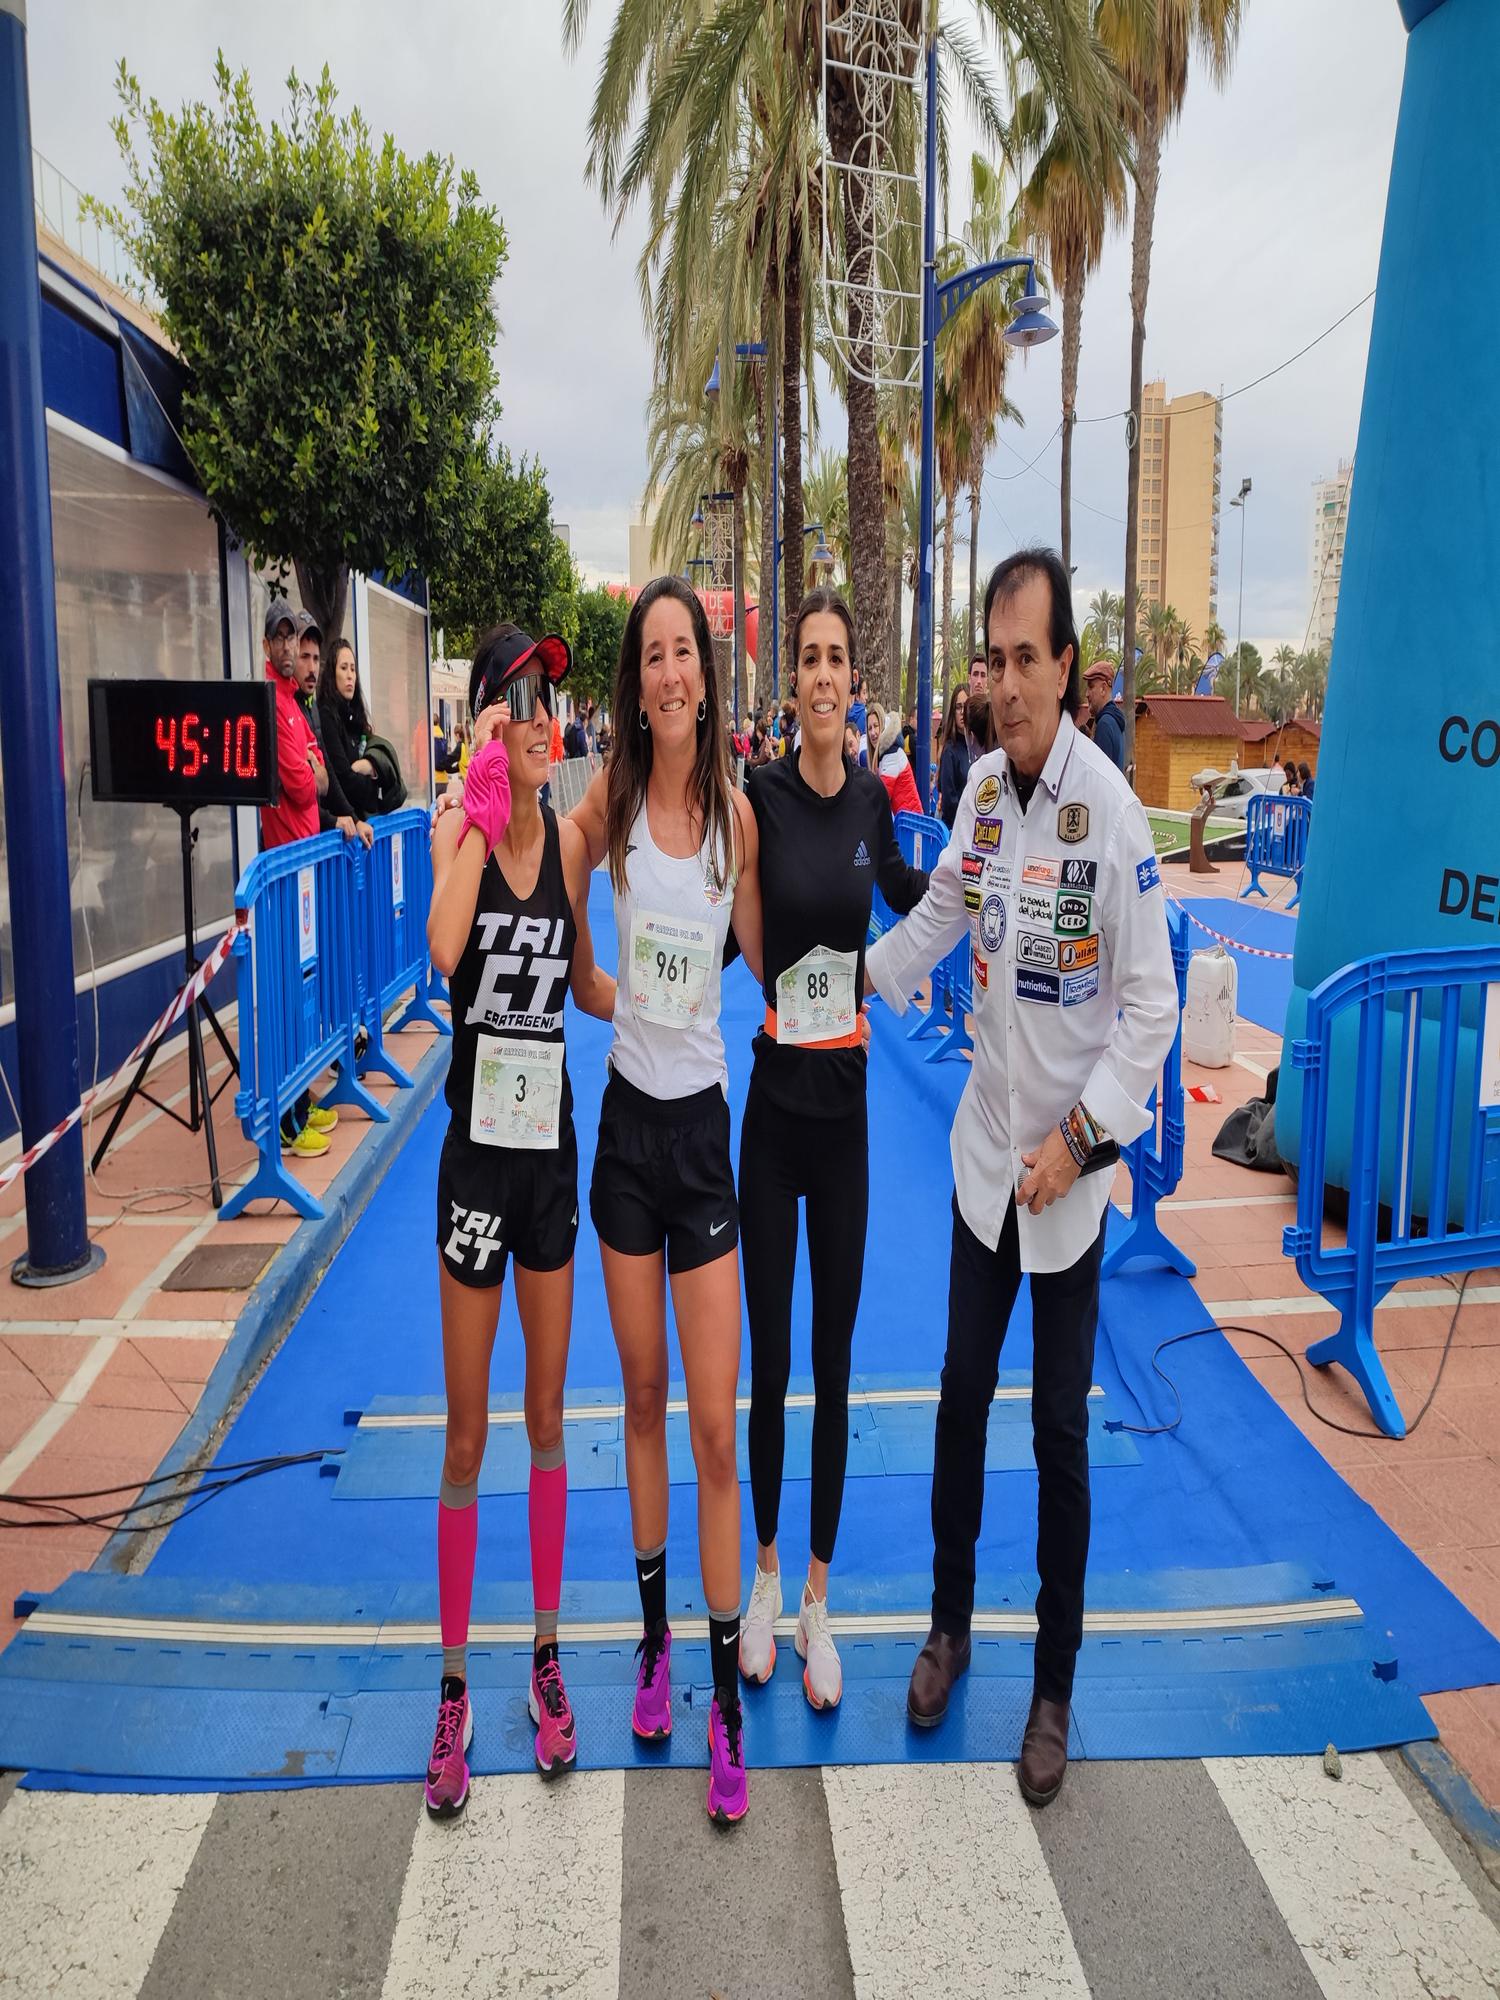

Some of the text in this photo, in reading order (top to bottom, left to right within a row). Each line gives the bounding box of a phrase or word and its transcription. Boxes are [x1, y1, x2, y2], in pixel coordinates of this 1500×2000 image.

[156, 714, 256, 776] 45:10
[1439, 716, 1500, 768] CO
[853, 857, 871, 867] adidas
[1018, 905, 1030, 916] del
[1020, 893, 1050, 909] la senda
[1061, 902, 1085, 912] ONDA
[1439, 868, 1500, 925] DE
[476, 912, 565, 956] TRI
[1061, 917, 1084, 926] CERO
[656, 950, 688, 984] 961
[1064, 946, 1098, 965] Julián
[807, 971, 829, 1000] 88
[515, 1074, 527, 1103] 3
[450, 1200, 502, 1238] TRI
[444, 1226, 502, 1270] CT
